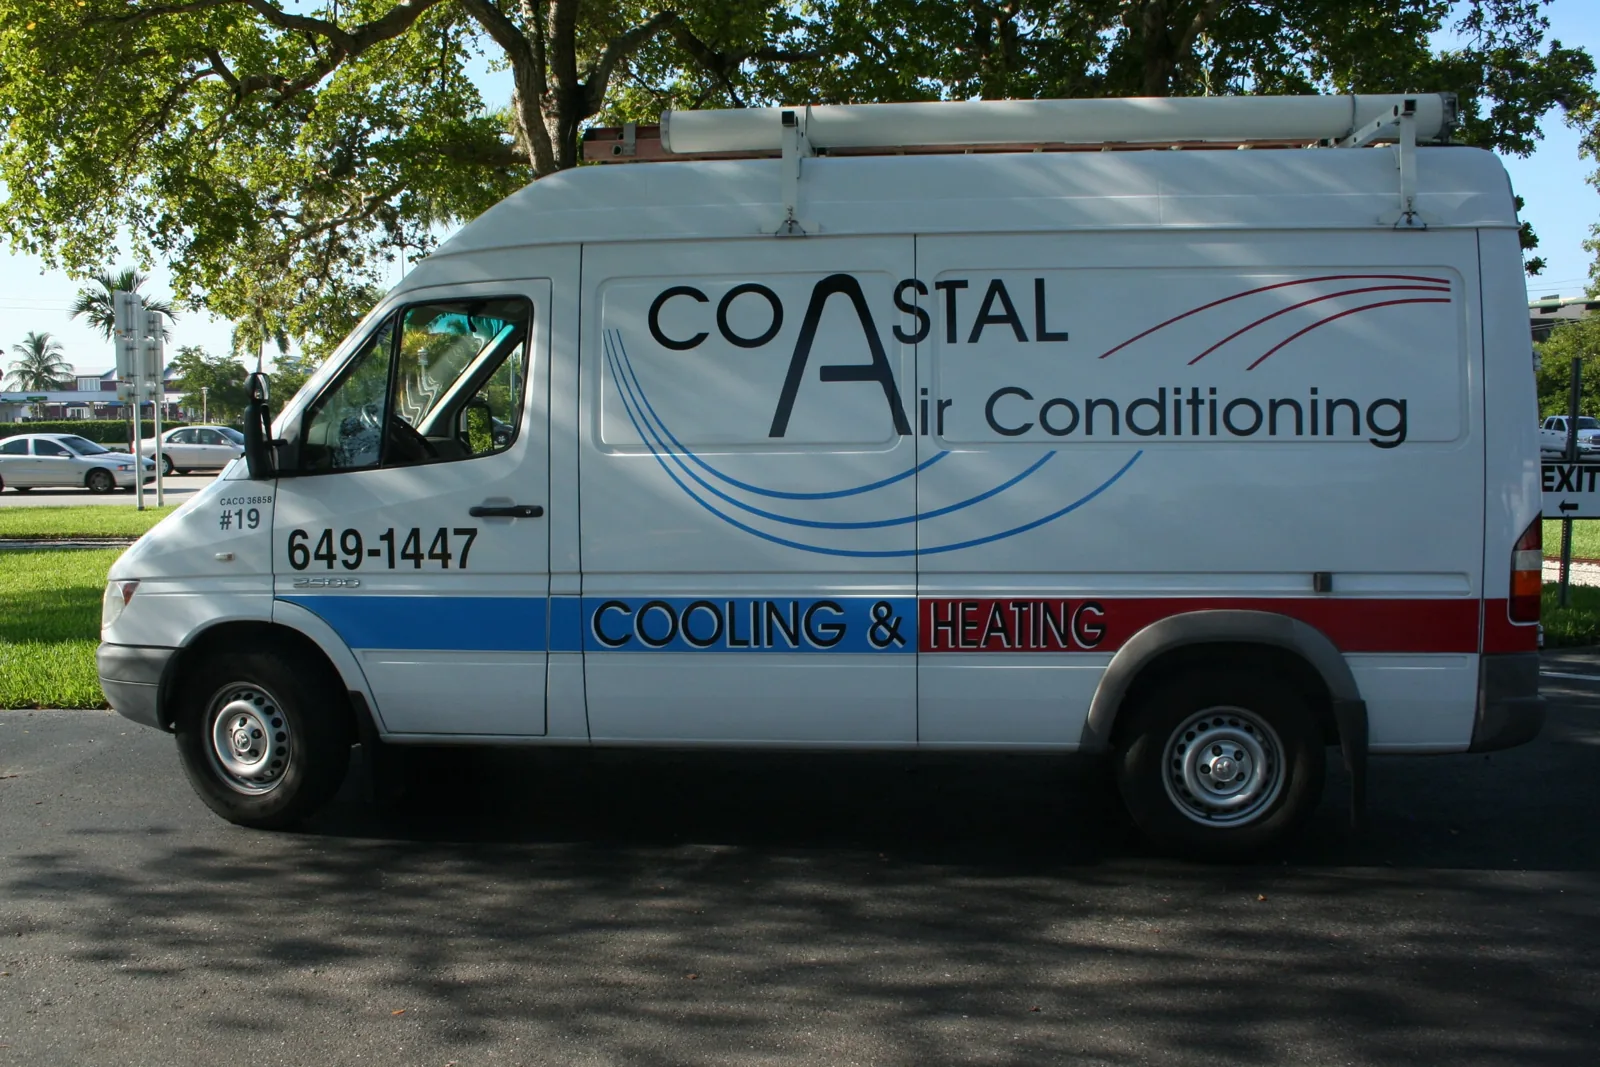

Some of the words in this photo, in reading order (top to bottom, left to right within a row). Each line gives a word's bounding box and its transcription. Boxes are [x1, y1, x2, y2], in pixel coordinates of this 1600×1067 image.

[648, 273, 1069, 438] COASTAL
[984, 386, 1408, 449] Conditioning
[1541, 465, 1600, 492] EXIT
[219, 508, 260, 530] #19
[220, 497, 245, 506] CACO
[287, 527, 478, 570] 649-1447
[591, 599, 847, 649] COOLING
[866, 600, 907, 649] &
[930, 600, 1107, 650] HEATING
